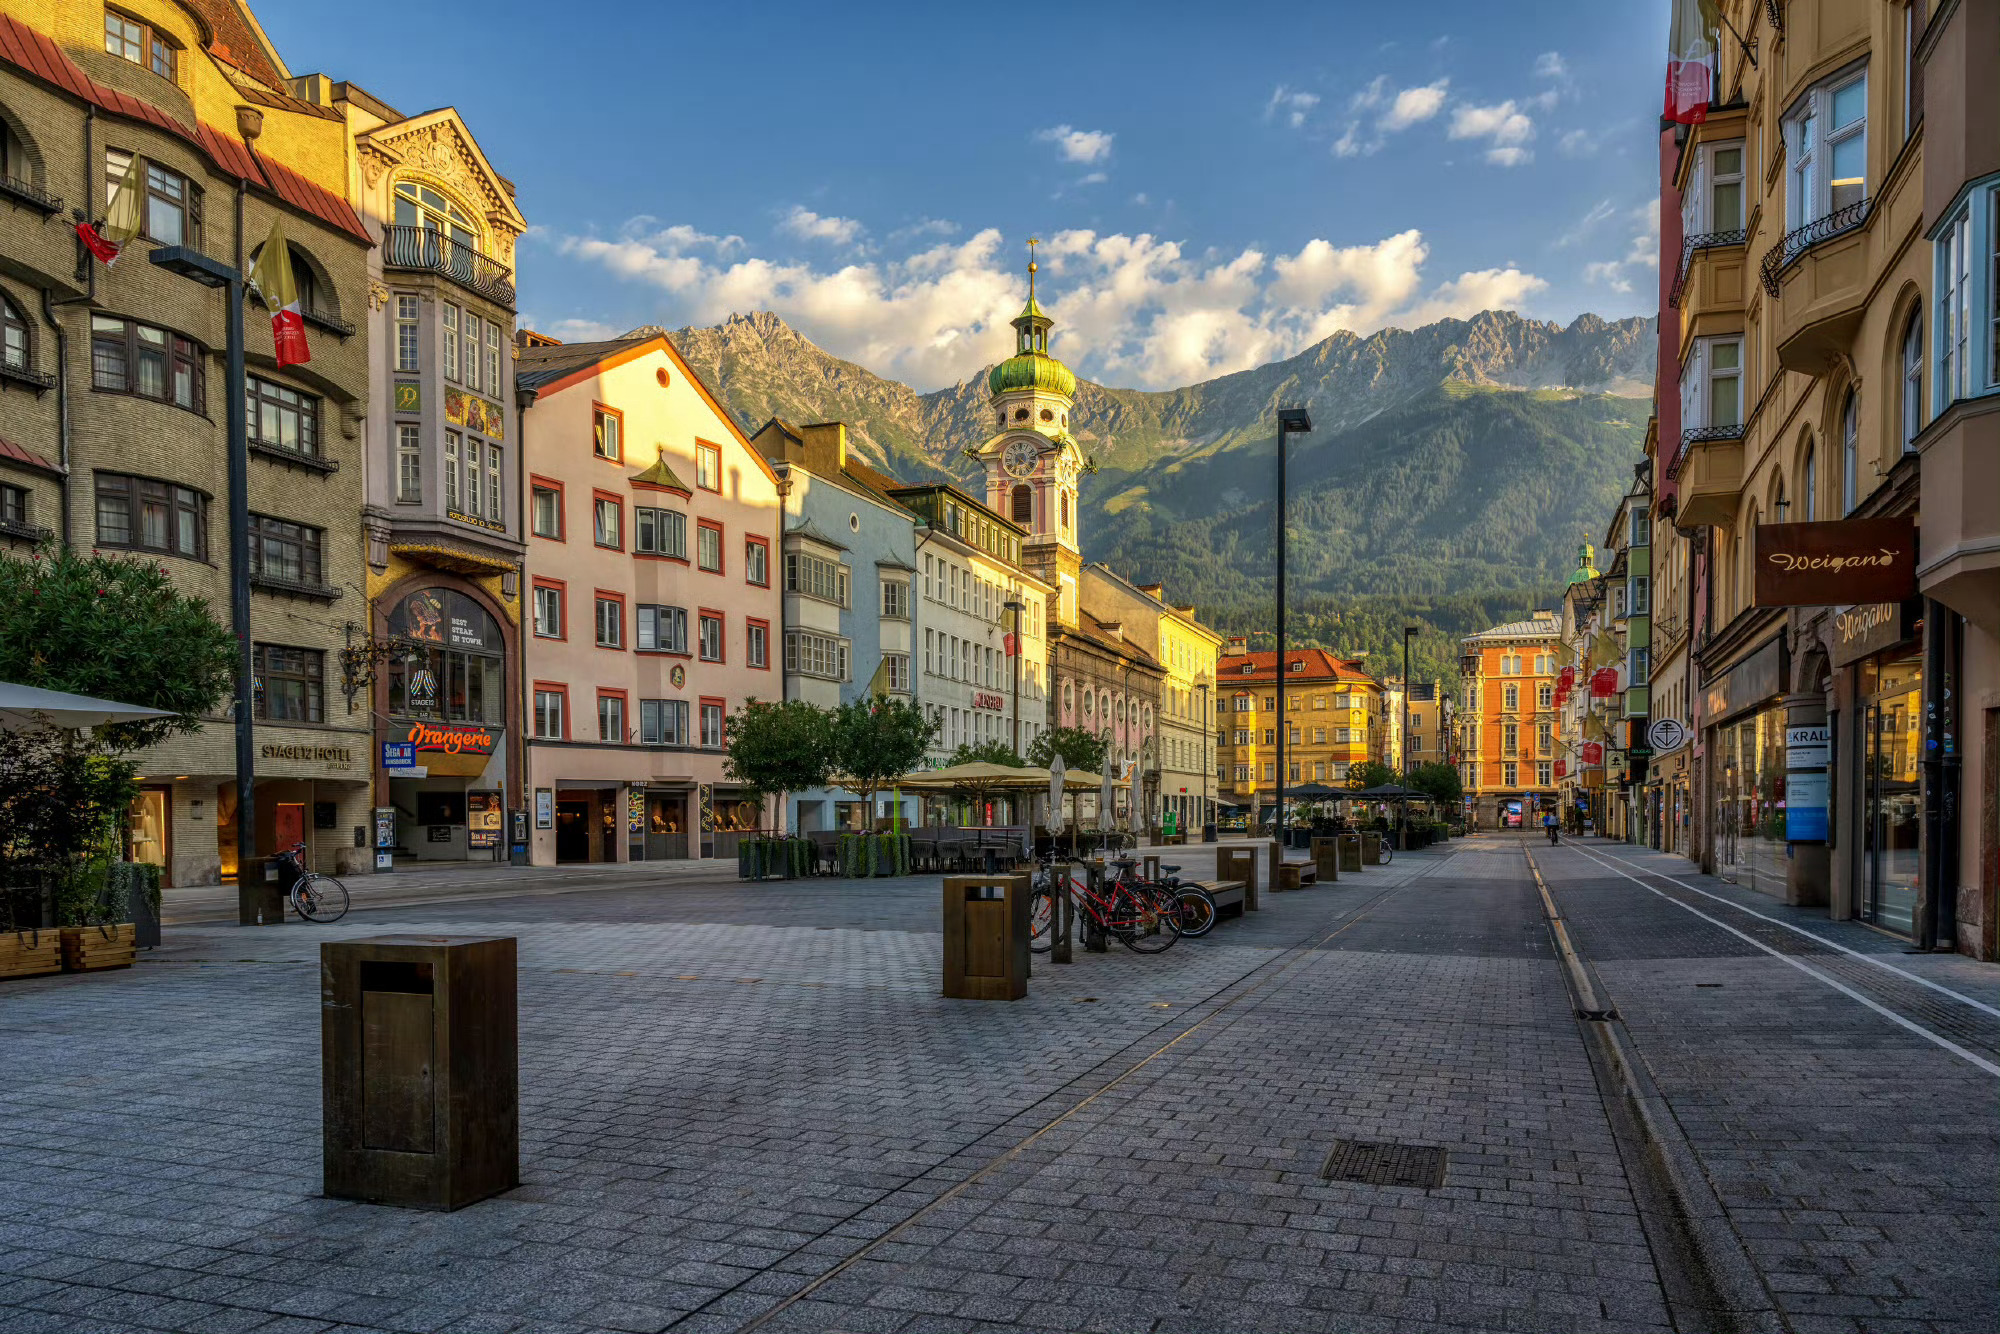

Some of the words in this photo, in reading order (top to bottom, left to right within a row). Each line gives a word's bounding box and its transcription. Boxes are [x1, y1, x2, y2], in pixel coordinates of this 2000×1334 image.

[1768, 548, 1900, 573] Weigand
[451, 617, 468, 627] BEST
[451, 626, 474, 636] STEAK
[452, 634, 460, 643] IN
[408, 721, 491, 754] Orangerie
[314, 746, 351, 762] HOTEL
